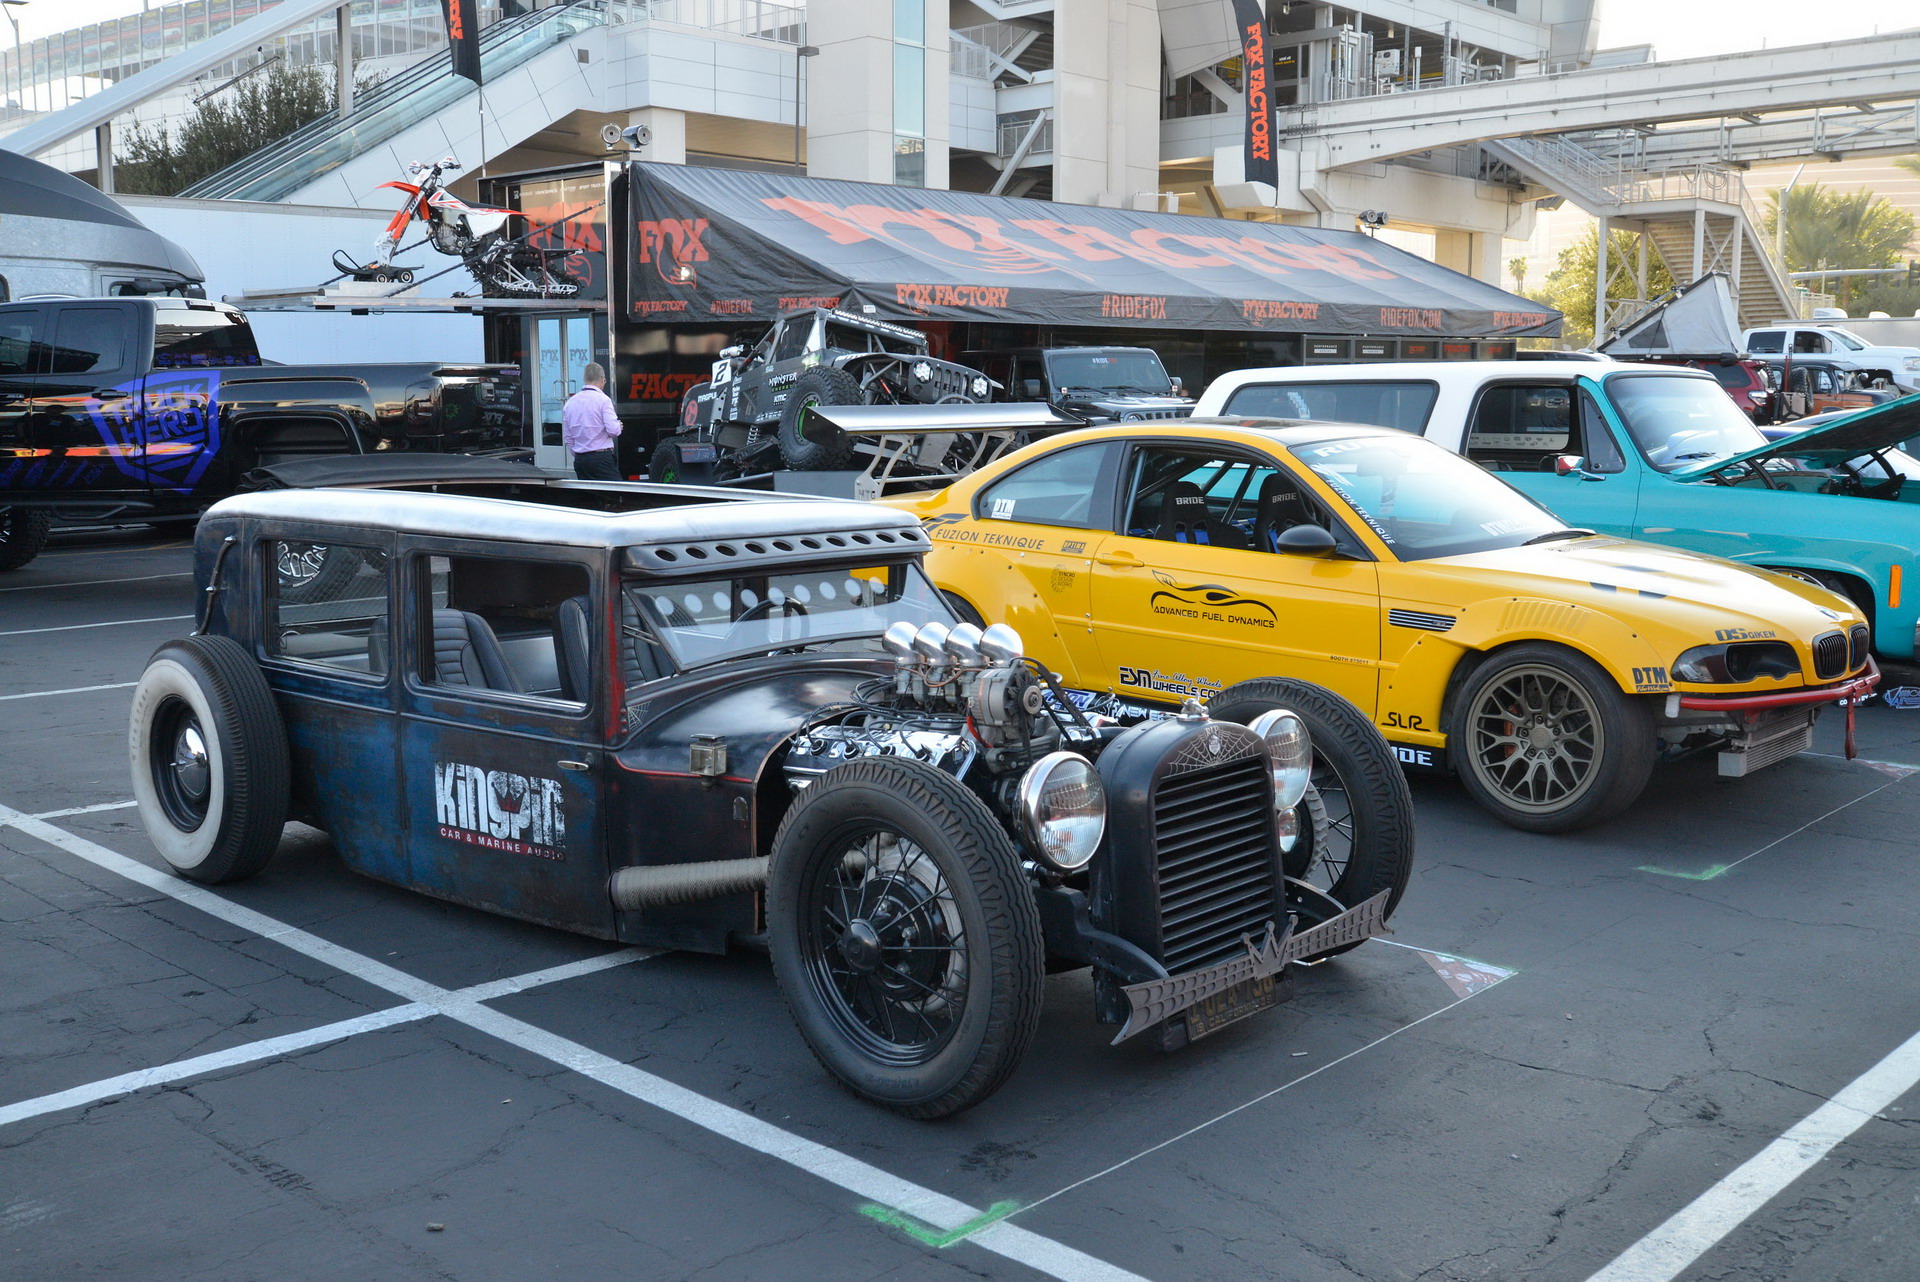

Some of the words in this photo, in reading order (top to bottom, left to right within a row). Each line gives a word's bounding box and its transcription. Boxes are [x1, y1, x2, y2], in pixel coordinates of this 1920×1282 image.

[1245, 22, 1264, 68] FOX
[1250, 67, 1270, 160] FACTORY
[525, 200, 604, 253] FOX
[638, 218, 710, 264] FOX
[651, 300, 689, 312] FACTORY
[797, 296, 840, 309] FACTORY
[896, 283, 933, 309] FOX
[934, 285, 1010, 308] FACTORY
[710, 299, 753, 314] #RIDEFOX
[1102, 294, 1167, 320] #RIDEFOX
[1243, 300, 1269, 319] FOX
[1269, 301, 1319, 319] FACTORY
[1380, 307, 1441, 328] RIDEFOX.COM
[1513, 311, 1547, 327] FACTORY
[541, 349, 559, 363] FOX
[570, 348, 589, 363] FOX
[714, 361, 729, 383] 2
[769, 371, 798, 386] MONSTER
[118, 407, 206, 450] HERO
[992, 498, 1016, 514] DTM
[1175, 496, 1205, 505] BRIDE
[1272, 492, 1297, 504] BRIDE
[1325, 479, 1355, 505] FUZION
[1355, 503, 1396, 545] TEKNIQUE
[935, 528, 980, 542] FUZION
[982, 532, 1045, 551] TEKNIQUE
[1153, 606, 1199, 619] ADVANCED
[1202, 612, 1225, 622] FUEL
[1228, 615, 1275, 629] DYNAMICS
[1714, 628, 1748, 642] OS
[1748, 630, 1776, 640] GIKEN
[1152, 669, 1170, 681] Fine
[1172, 672, 1194, 688] Alloy
[1194, 676, 1224, 689] Wheels
[1632, 666, 1669, 684] DTM
[1381, 712, 1431, 732] SLR
[440, 827, 461, 840] CAR
[466, 833, 473, 842] &
[478, 836, 521, 853] MARINE
[527, 847, 565, 861] AUDIO
